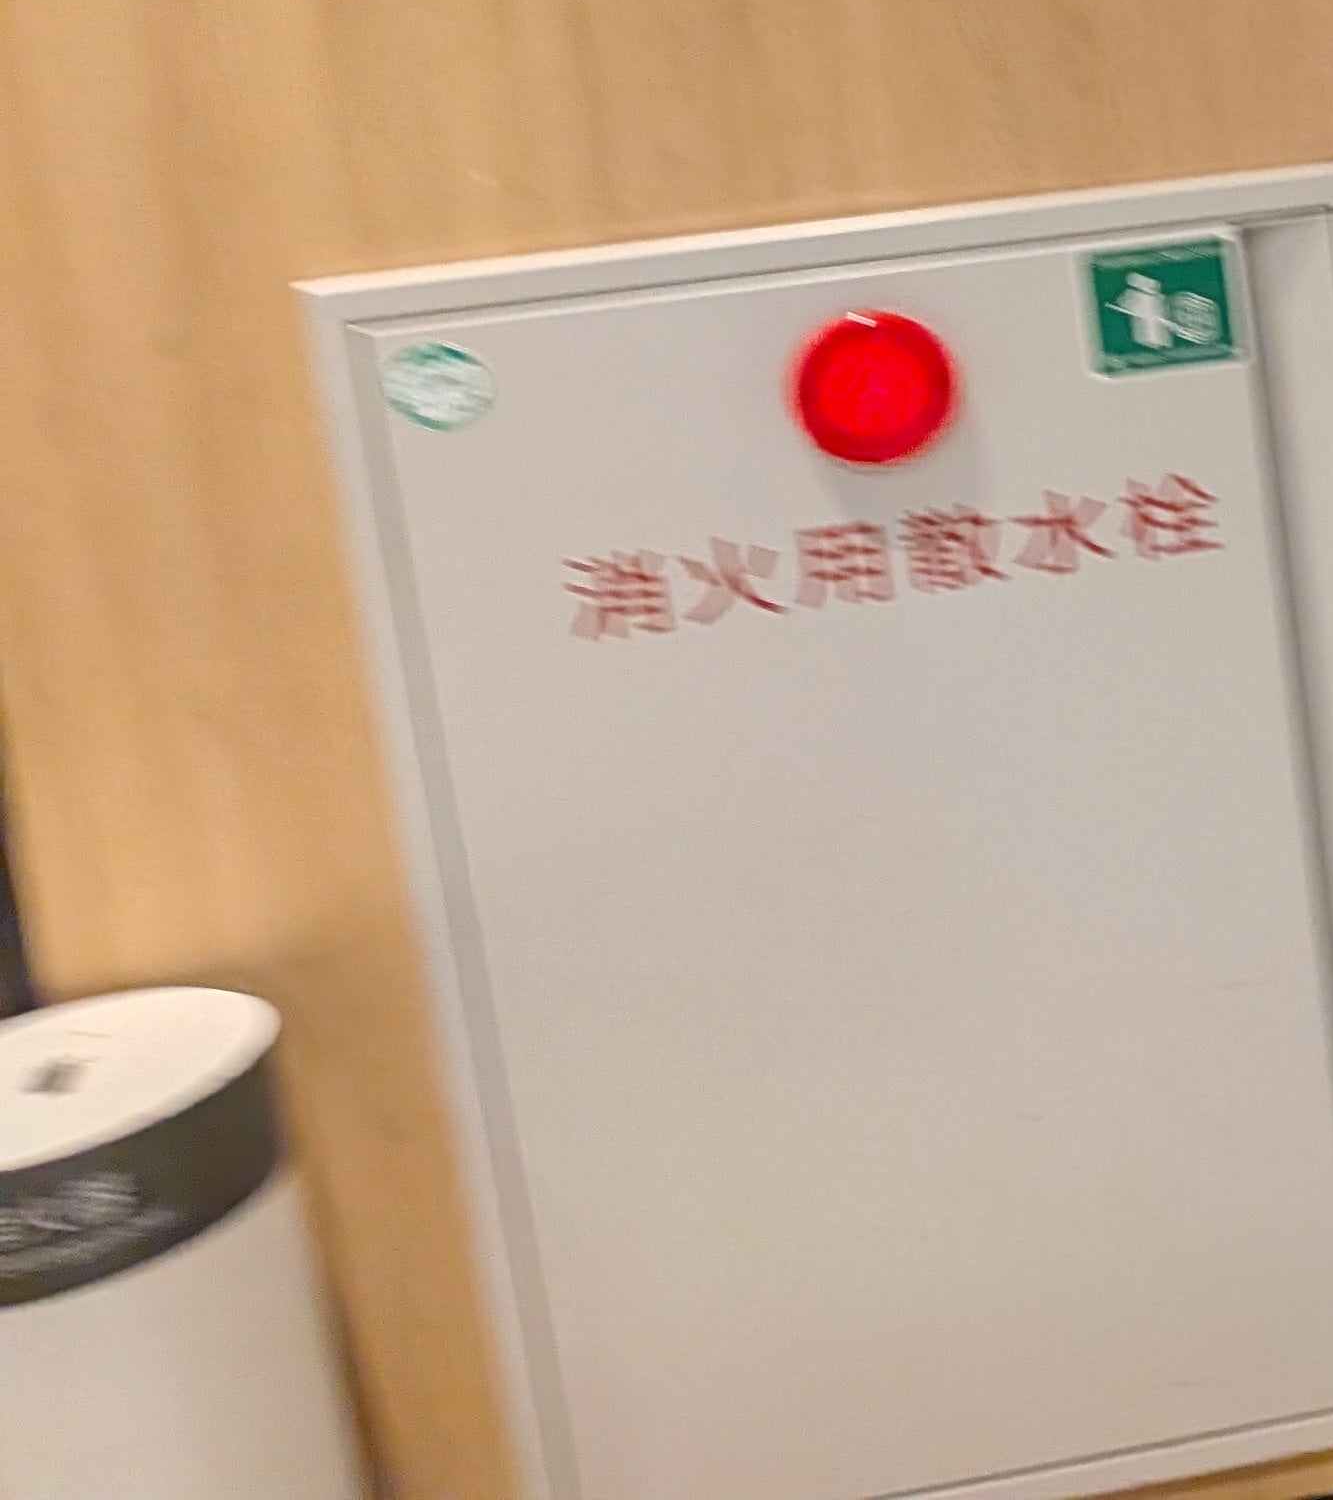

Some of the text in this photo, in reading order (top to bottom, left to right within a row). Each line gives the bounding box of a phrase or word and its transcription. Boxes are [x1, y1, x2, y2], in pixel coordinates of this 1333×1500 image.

[562, 473, 1223, 640] 消火用散水栓
